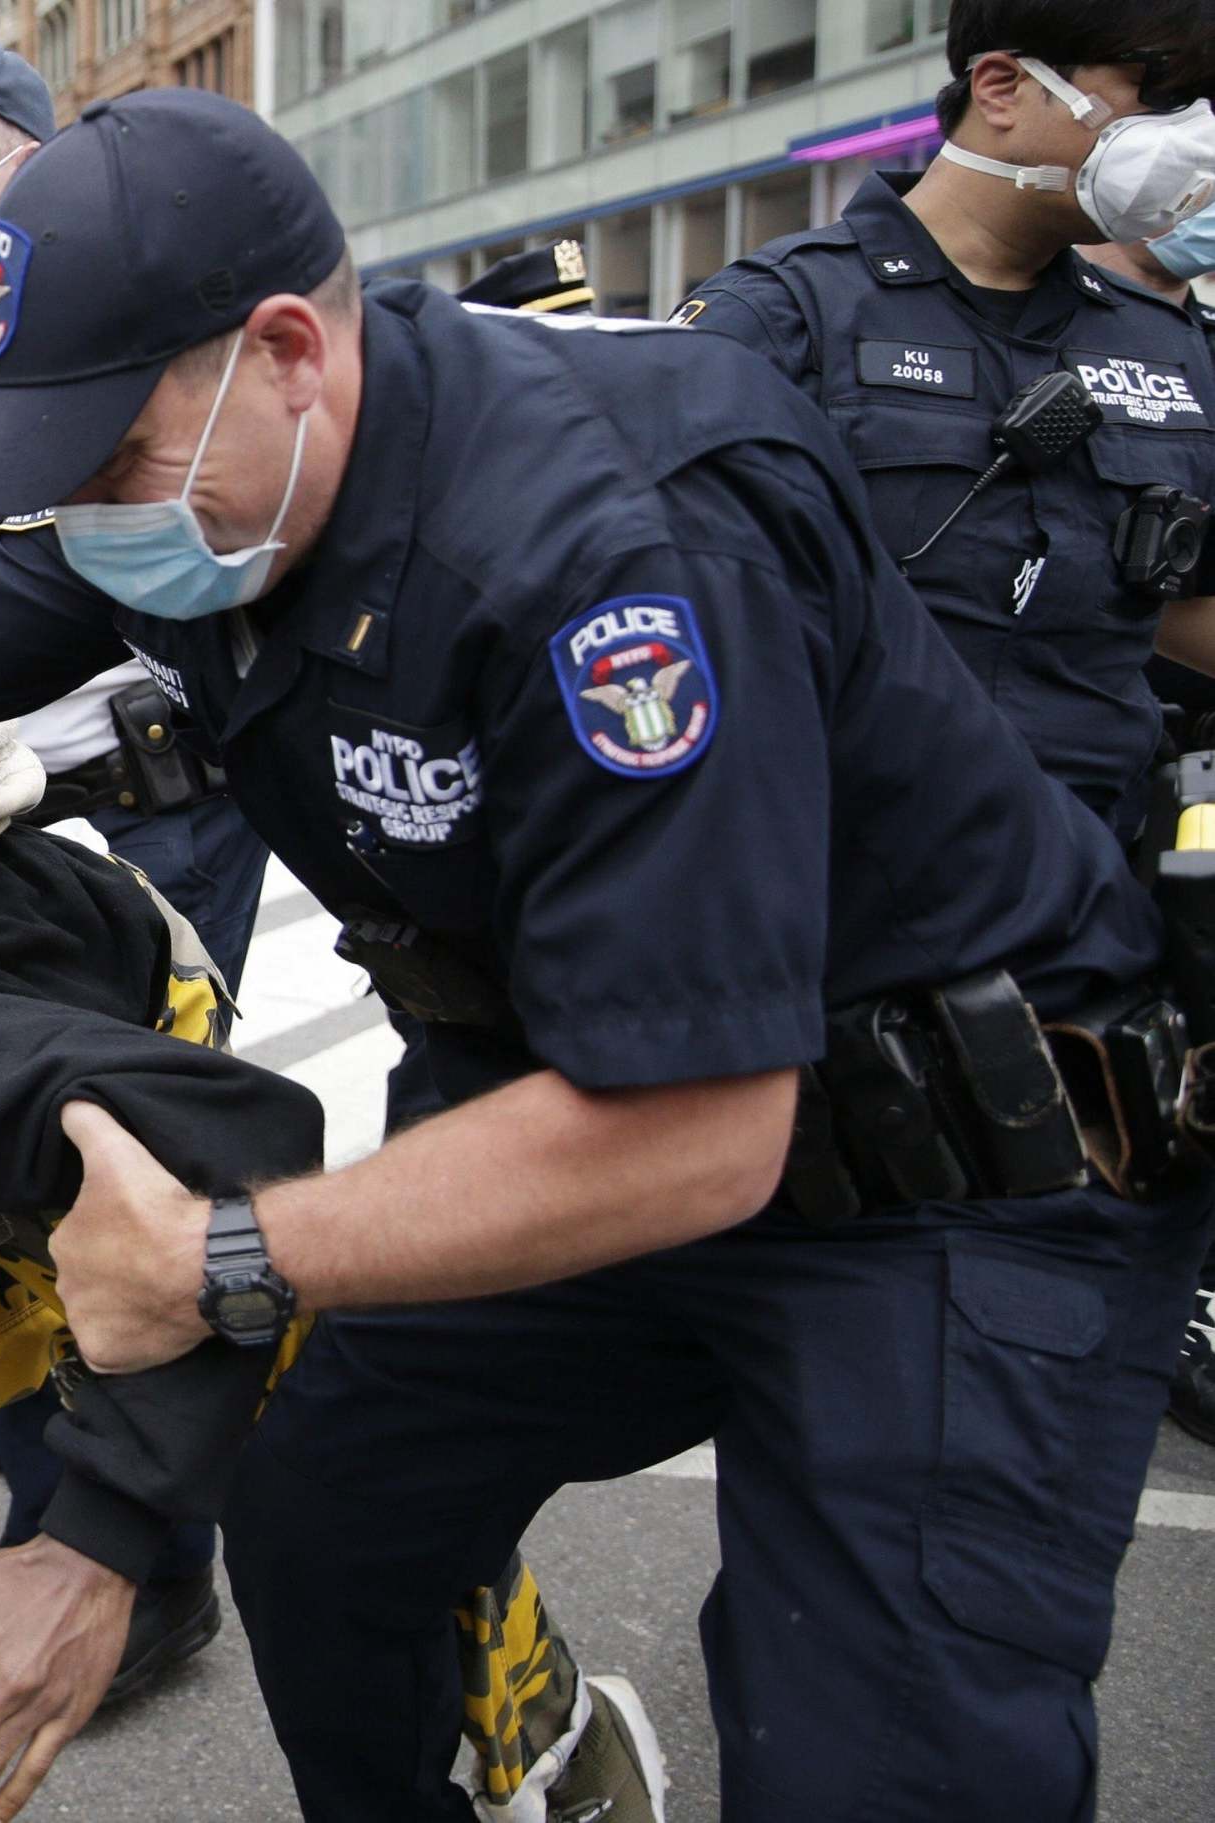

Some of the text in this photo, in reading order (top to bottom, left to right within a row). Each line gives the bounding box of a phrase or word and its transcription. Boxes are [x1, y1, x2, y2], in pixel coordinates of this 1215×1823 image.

[882, 259, 911, 273] S4
[904, 350, 930, 366] KU
[1107, 358, 1146, 373] NYPD
[891, 364, 944, 384] 20058
[1076, 365, 1194, 401] POLICE
[1089, 391, 1204, 415] TRATEGIC RESPONSE
[1126, 406, 1167, 423] GROUP
[569, 606, 682, 666] POLICE
[371, 728, 424, 761] NYPD
[330, 735, 480, 804] POLICE
[380, 816, 453, 843] GROUP
